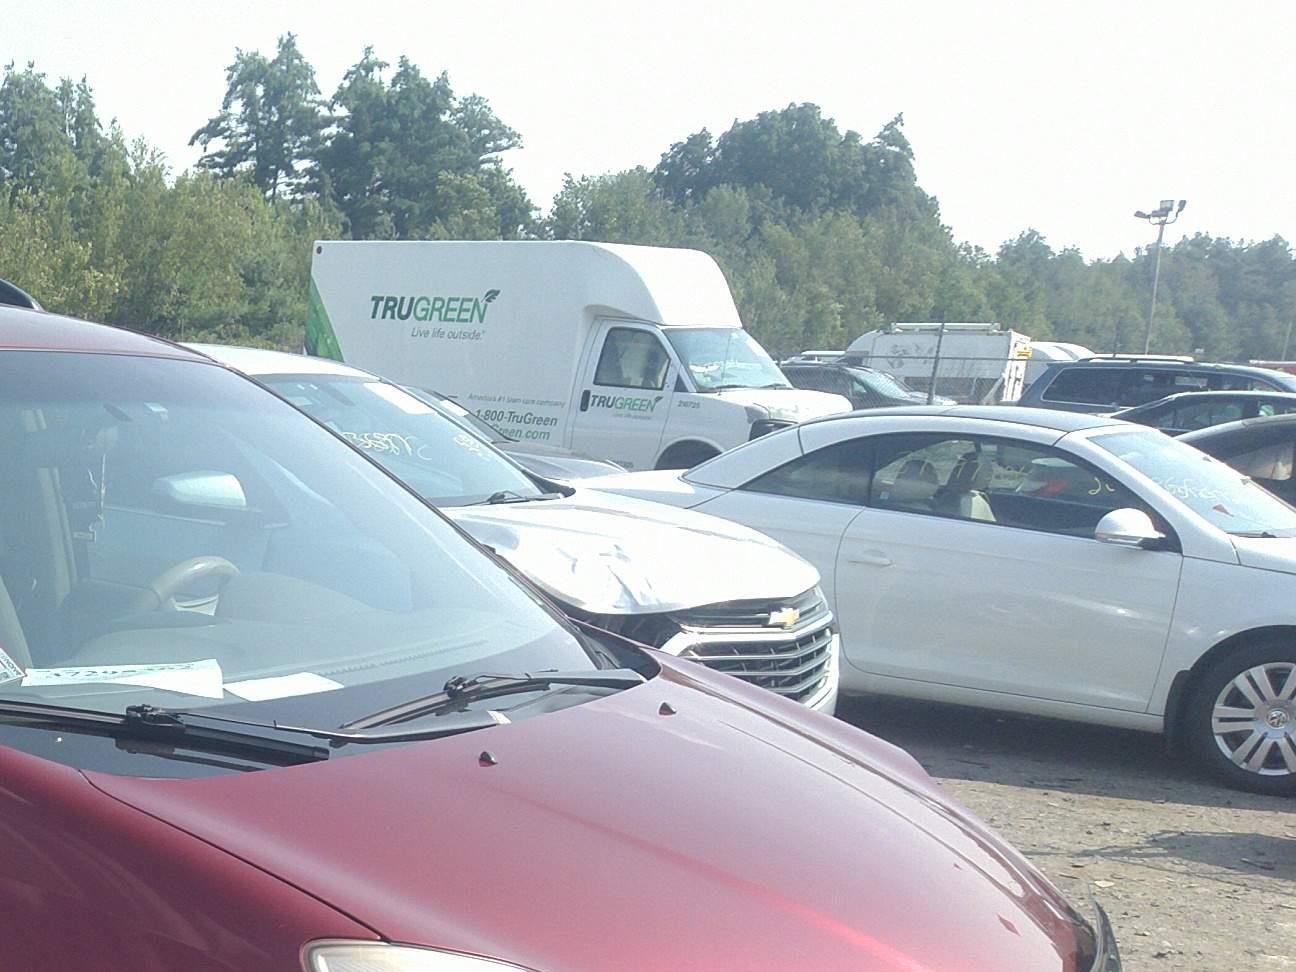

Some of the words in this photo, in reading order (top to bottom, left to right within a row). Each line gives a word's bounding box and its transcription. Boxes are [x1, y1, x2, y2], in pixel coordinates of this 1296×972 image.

[371, 295, 489, 324] TRUGREEN
[411, 328, 430, 338] Live
[431, 328, 445, 339] life
[591, 394, 657, 412] TRUGREEN
[476, 408, 558, 427] 1-800-TruGreen
